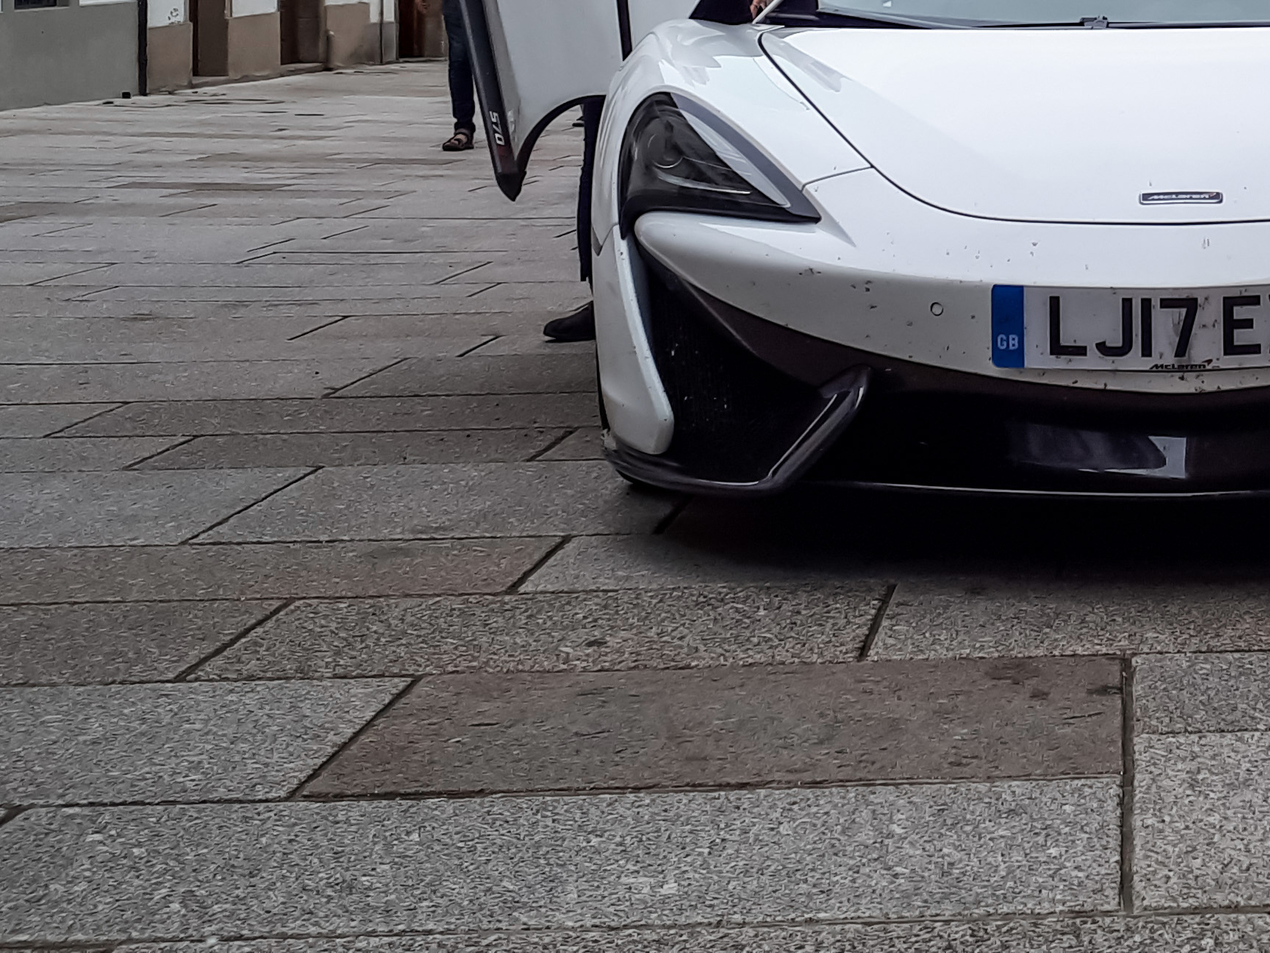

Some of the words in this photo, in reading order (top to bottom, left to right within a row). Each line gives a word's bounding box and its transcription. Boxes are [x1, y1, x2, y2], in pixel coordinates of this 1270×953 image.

[489, 110, 505, 145] 570
[997, 334, 1019, 350] GB
[1048, 295, 1199, 358] LJ17
